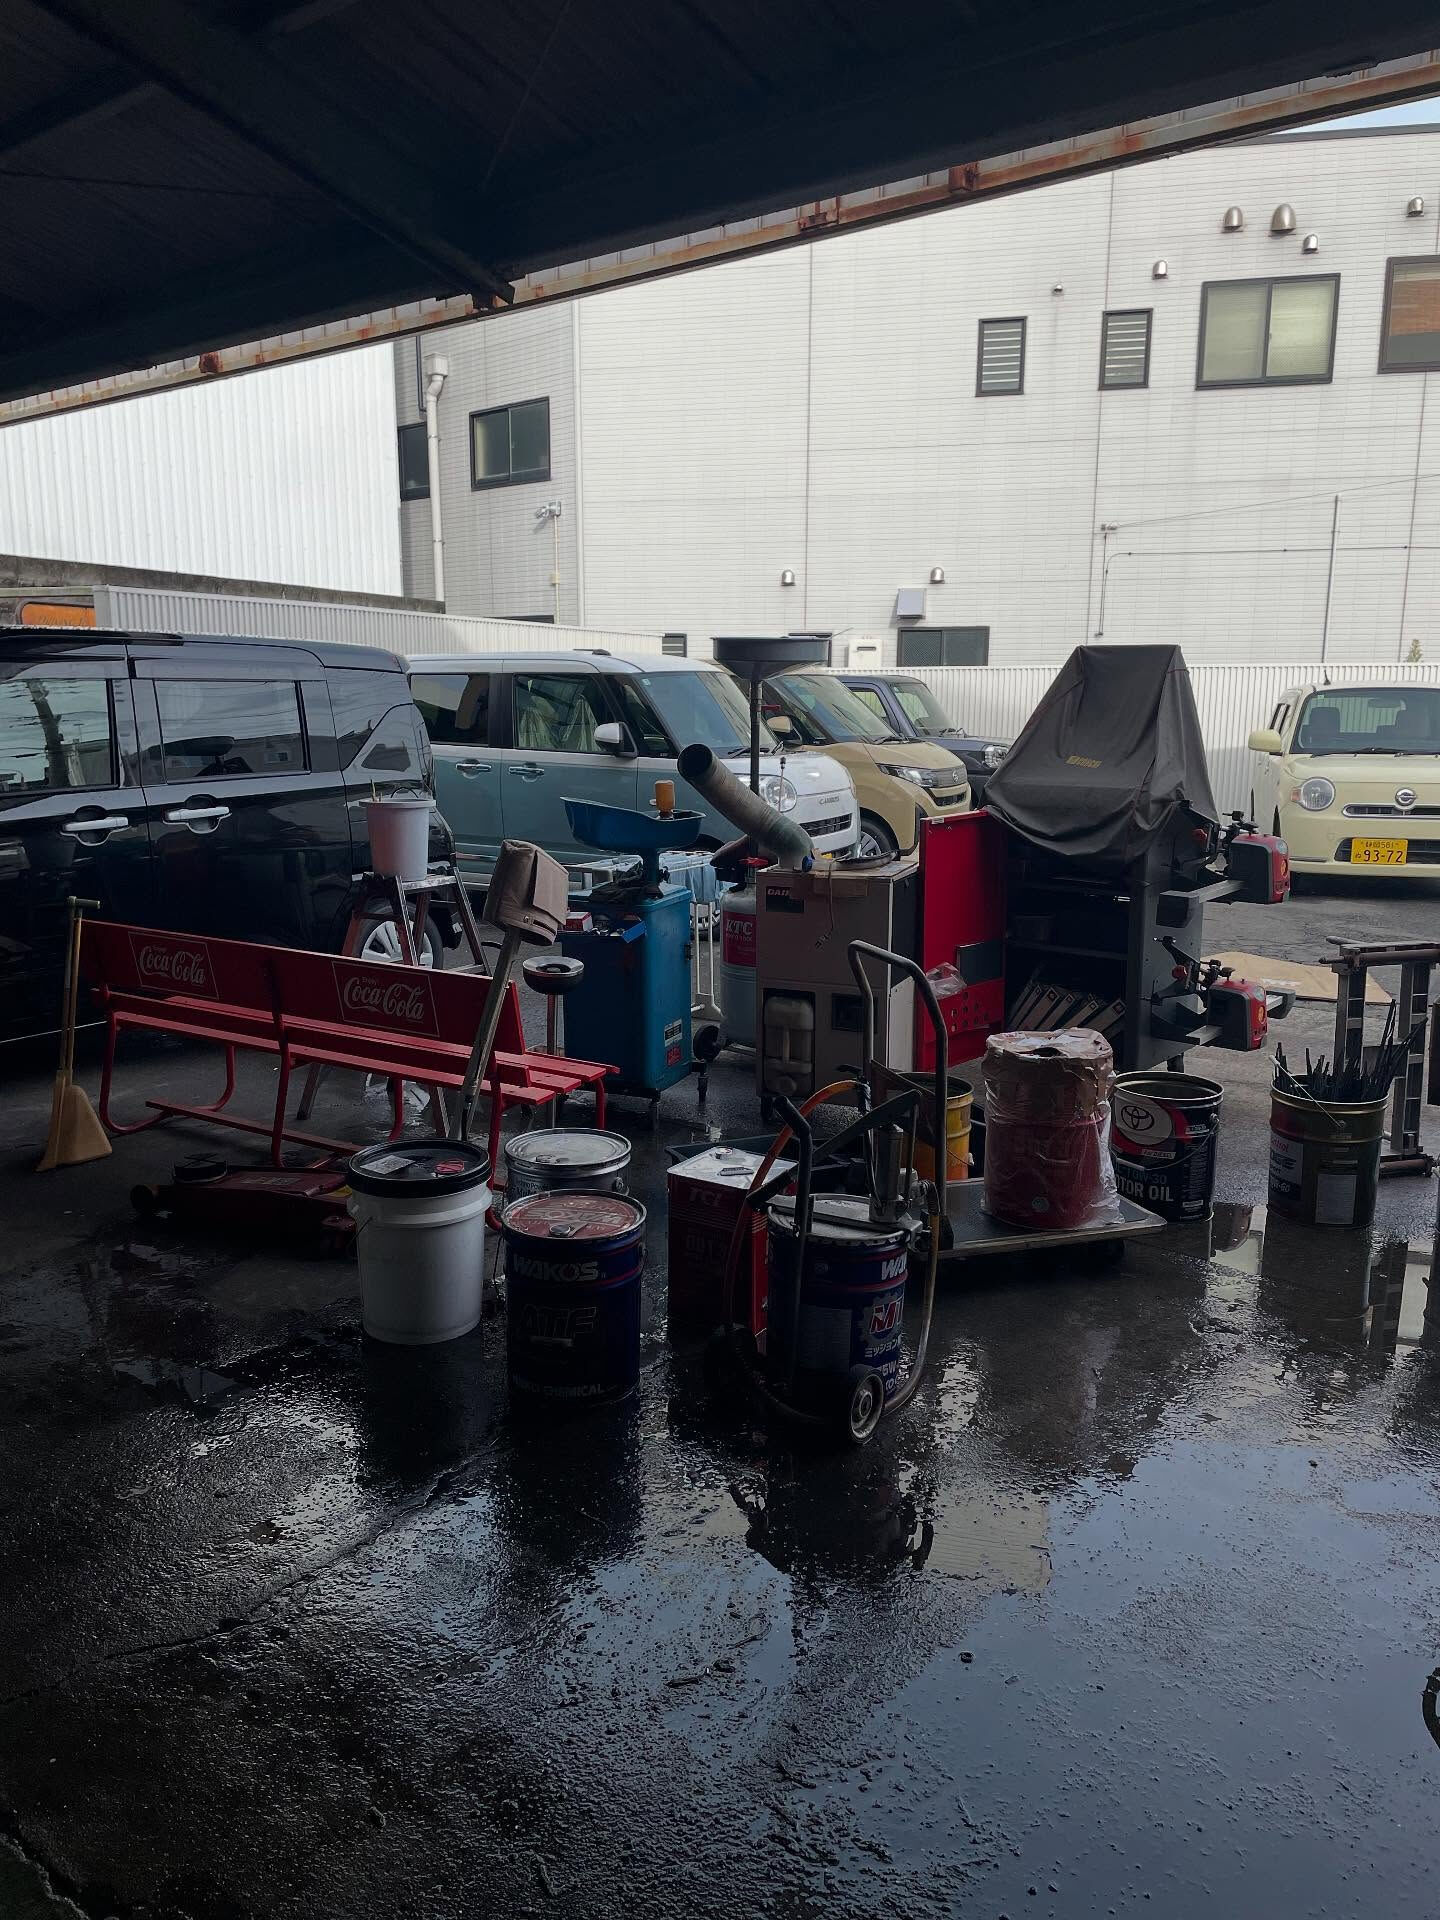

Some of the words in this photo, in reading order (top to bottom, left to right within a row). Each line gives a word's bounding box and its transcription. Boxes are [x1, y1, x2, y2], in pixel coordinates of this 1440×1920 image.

[1363, 850, 1398, 863] 93-72
[1116, 1174, 1144, 1198] OTOR
[1148, 1185, 1174, 1202] OIL
